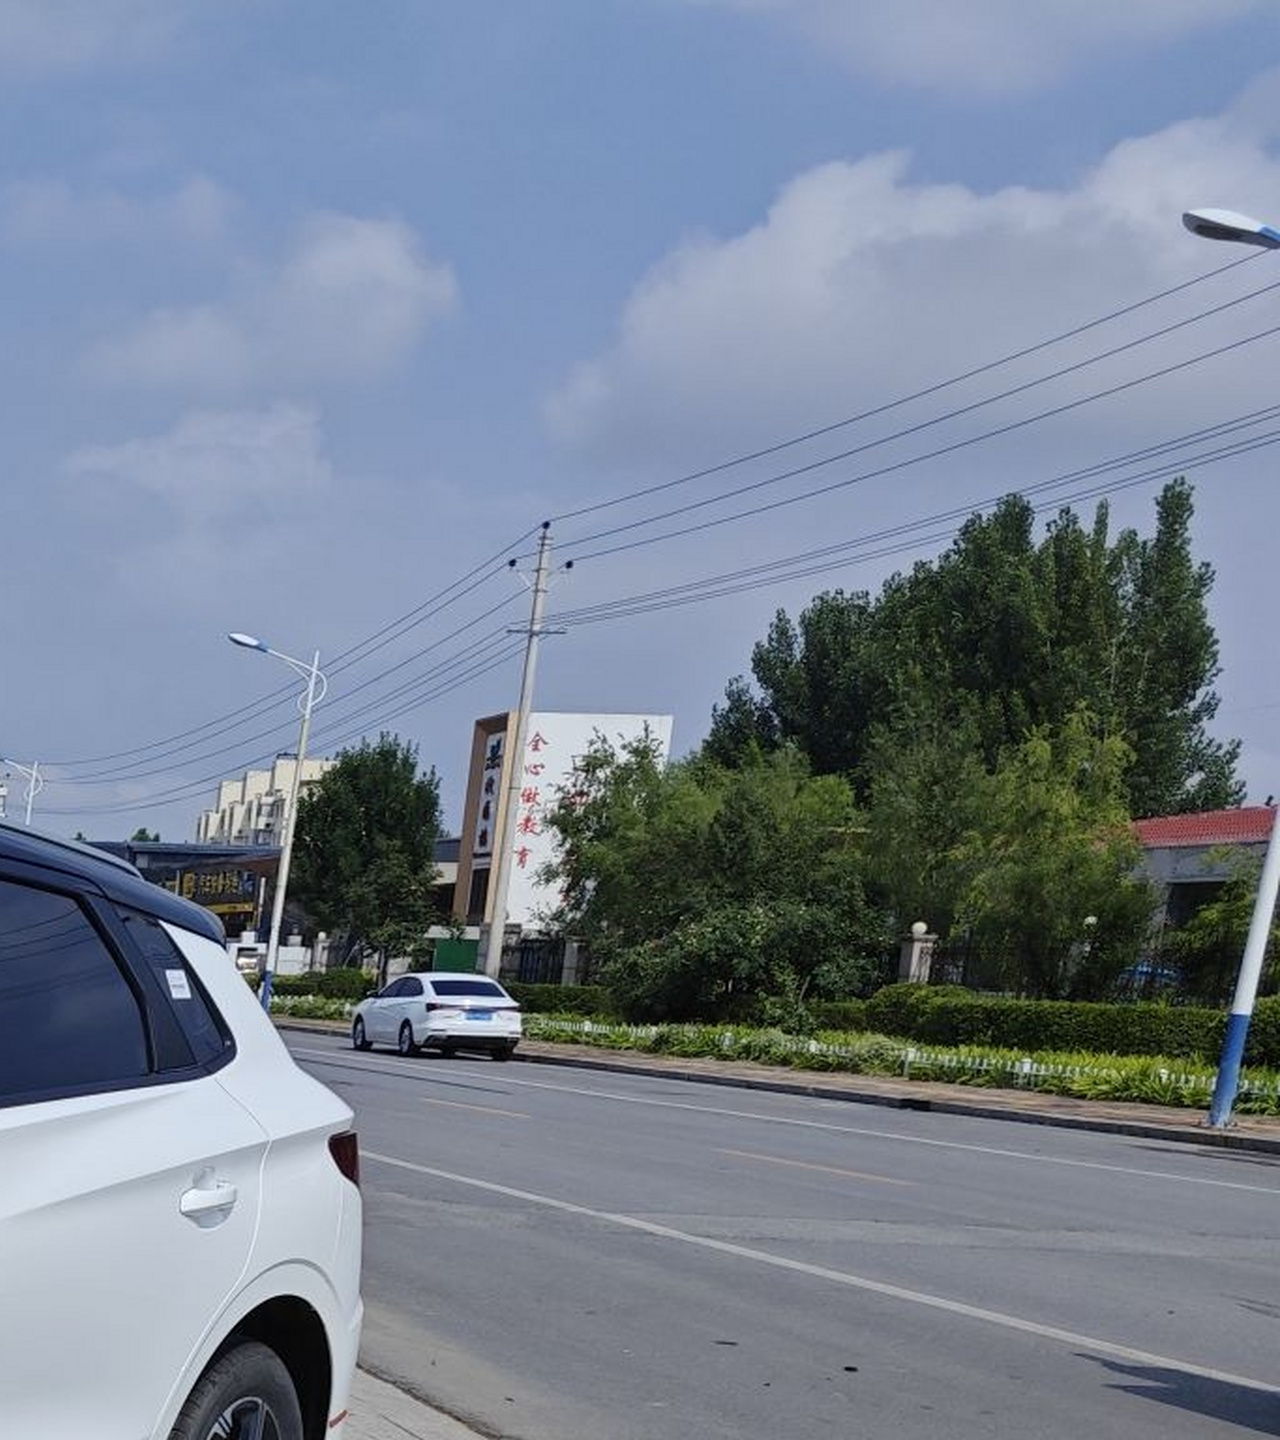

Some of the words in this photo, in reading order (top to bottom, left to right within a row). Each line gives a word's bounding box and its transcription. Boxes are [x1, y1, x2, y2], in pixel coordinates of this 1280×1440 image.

[514, 731, 549, 869] 全心做教育
